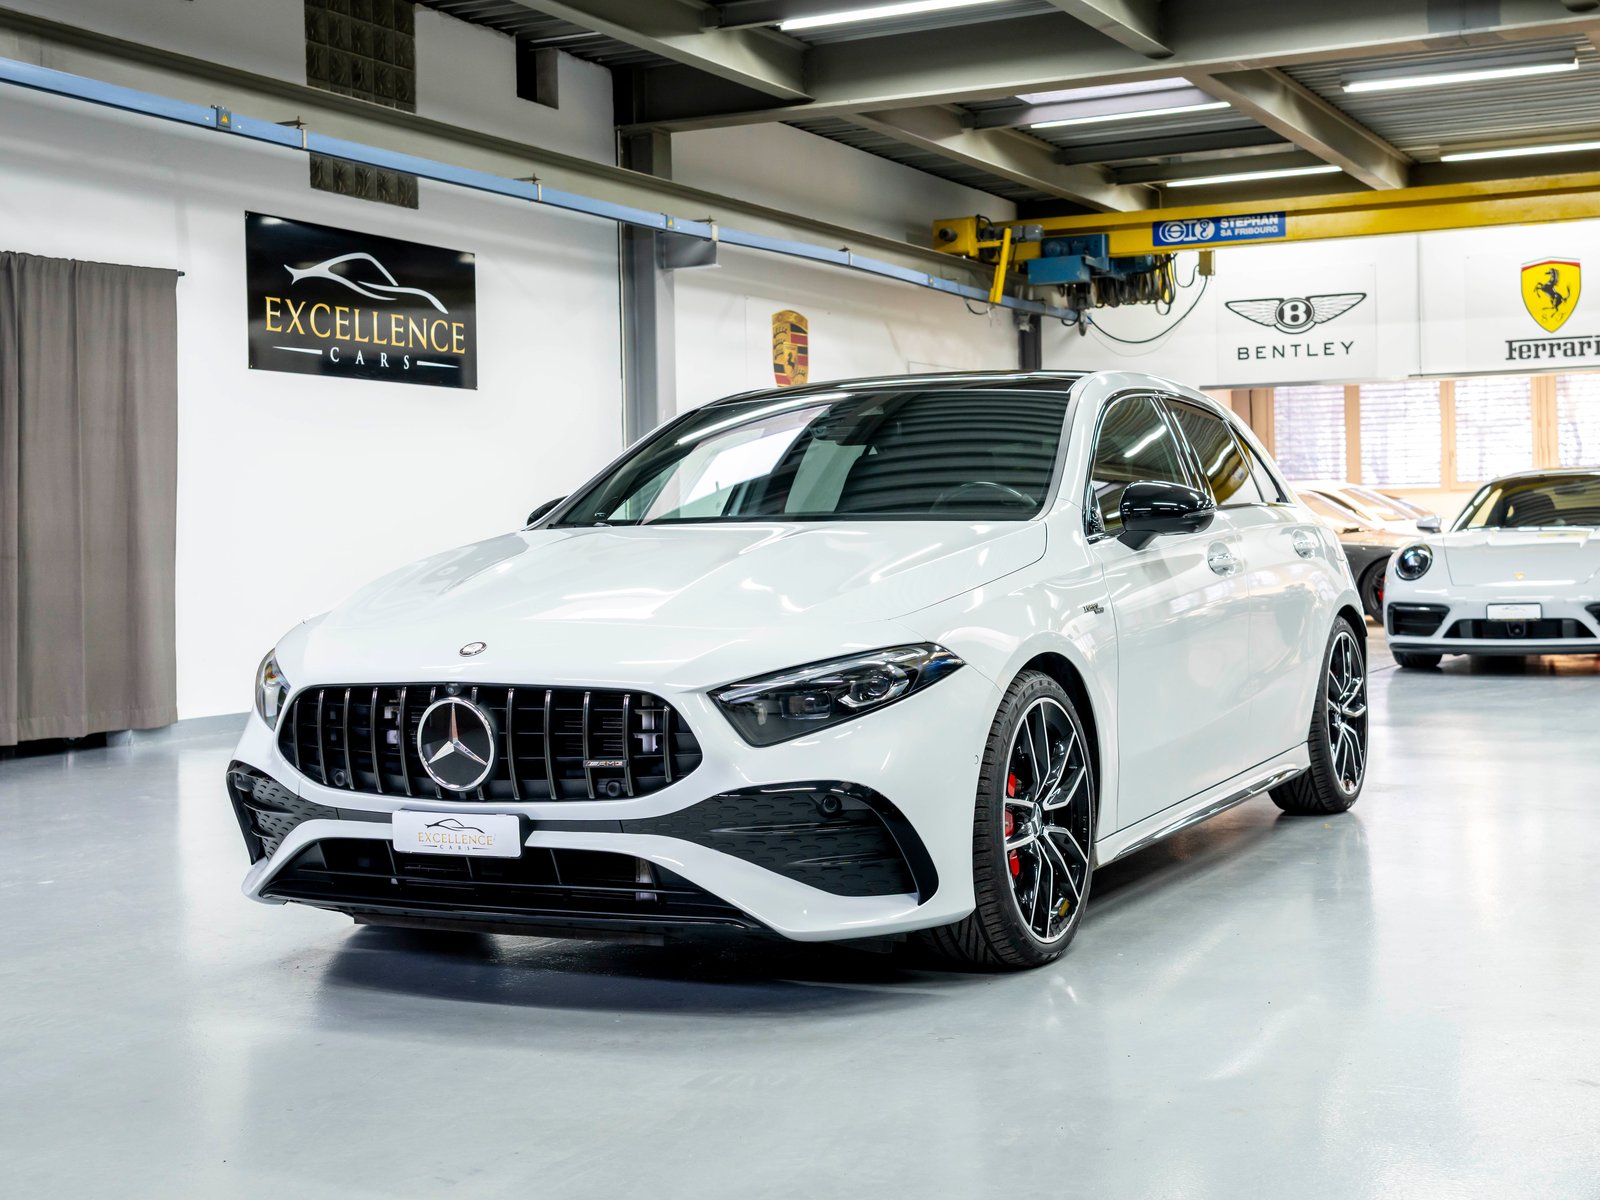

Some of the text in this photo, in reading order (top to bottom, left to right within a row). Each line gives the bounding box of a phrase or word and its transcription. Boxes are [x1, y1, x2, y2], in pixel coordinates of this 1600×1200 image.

[1220, 214, 1279, 229] STEPHAN
[1220, 225, 1279, 237] SA FRIBOURG
[265, 296, 466, 354] EXCELLENCE
[329, 347, 410, 370] CARS
[1237, 341, 1354, 360] BENTLEY
[417, 832, 494, 846] EXCELLENCE
